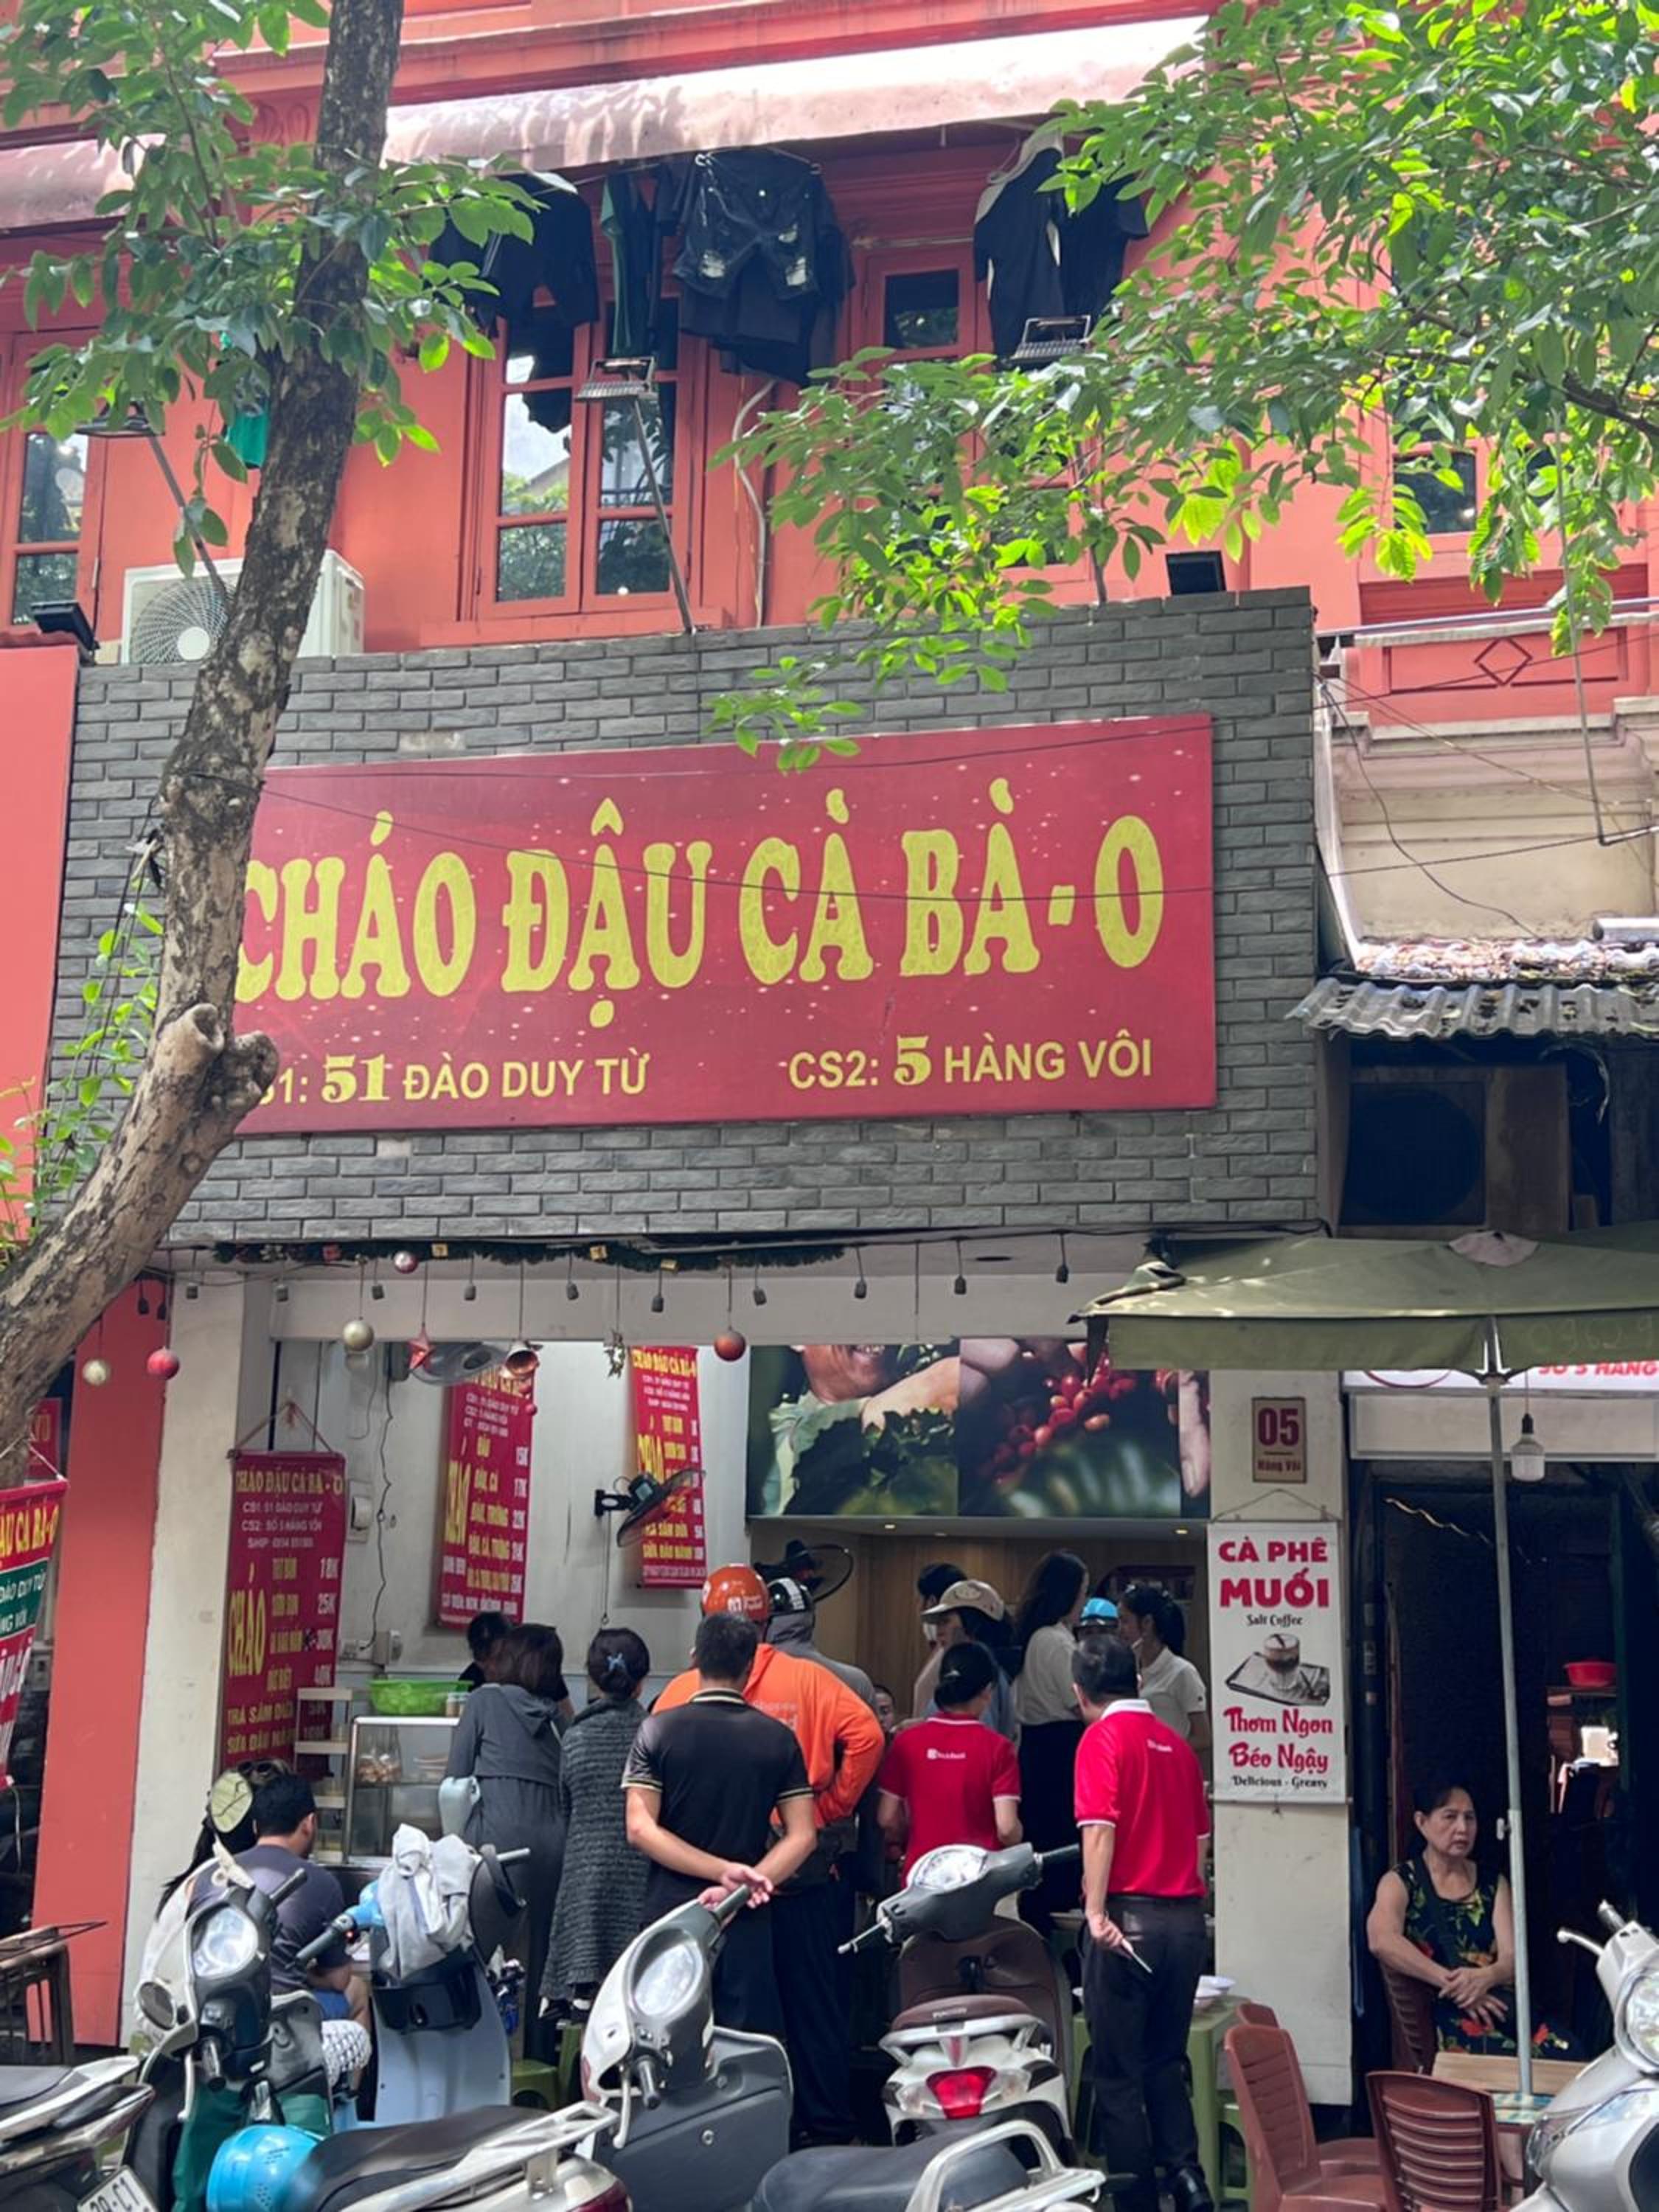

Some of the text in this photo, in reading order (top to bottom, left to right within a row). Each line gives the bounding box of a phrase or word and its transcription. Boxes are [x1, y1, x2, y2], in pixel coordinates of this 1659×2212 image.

[234, 810, 476, 1003] CHÁO
[501, 796, 713, 1028] ĐẬU
[320, 1053, 391, 1104] 51
[402, 1051, 490, 1101] ĐÀO
[501, 1059, 585, 1099] DUY
[594, 1047, 651, 1096] TỪ
[788, 1028, 1152, 1090] CS2: 5 HÀNG VÔI
[1257, 1407, 1299, 1447] 05
[1218, 1536, 1329, 1563] CÀ PHÊ
[1219, 1568, 1329, 1608] MUỐI
[1246, 1613, 1304, 1627] Salt Coffee
[1223, 1706, 1333, 1738] Thơm Ngon
[1228, 1742, 1329, 1774] Béo Ngậy
